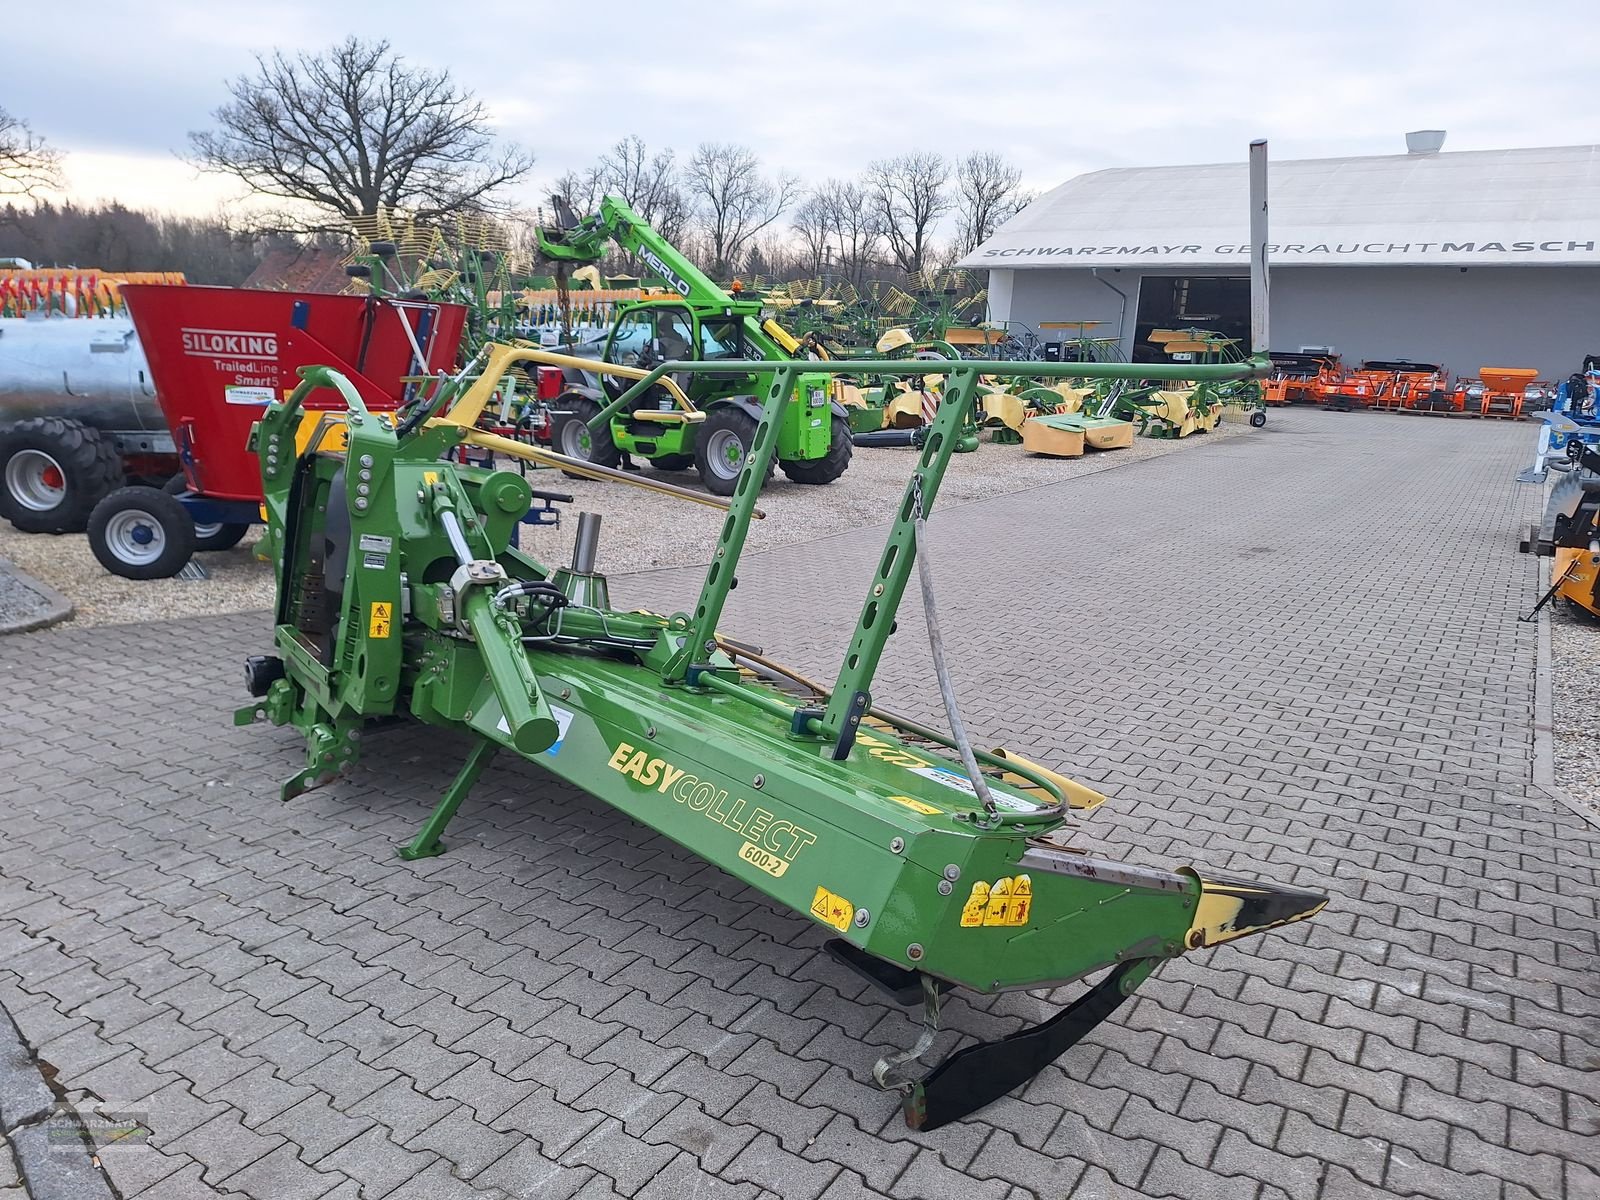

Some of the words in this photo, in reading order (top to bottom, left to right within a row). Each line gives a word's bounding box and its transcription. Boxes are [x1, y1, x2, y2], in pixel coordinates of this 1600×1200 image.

[982, 244, 1202, 257] SCHWARZMAYR
[638, 244, 690, 296] MERLO
[182, 334, 278, 355] SILOKING
[213, 360, 278, 374] TrailedLine
[235, 374, 279, 387] Smart5
[607, 742, 818, 861] EASYCOLLECT
[744, 846, 782, 873] 600-2
